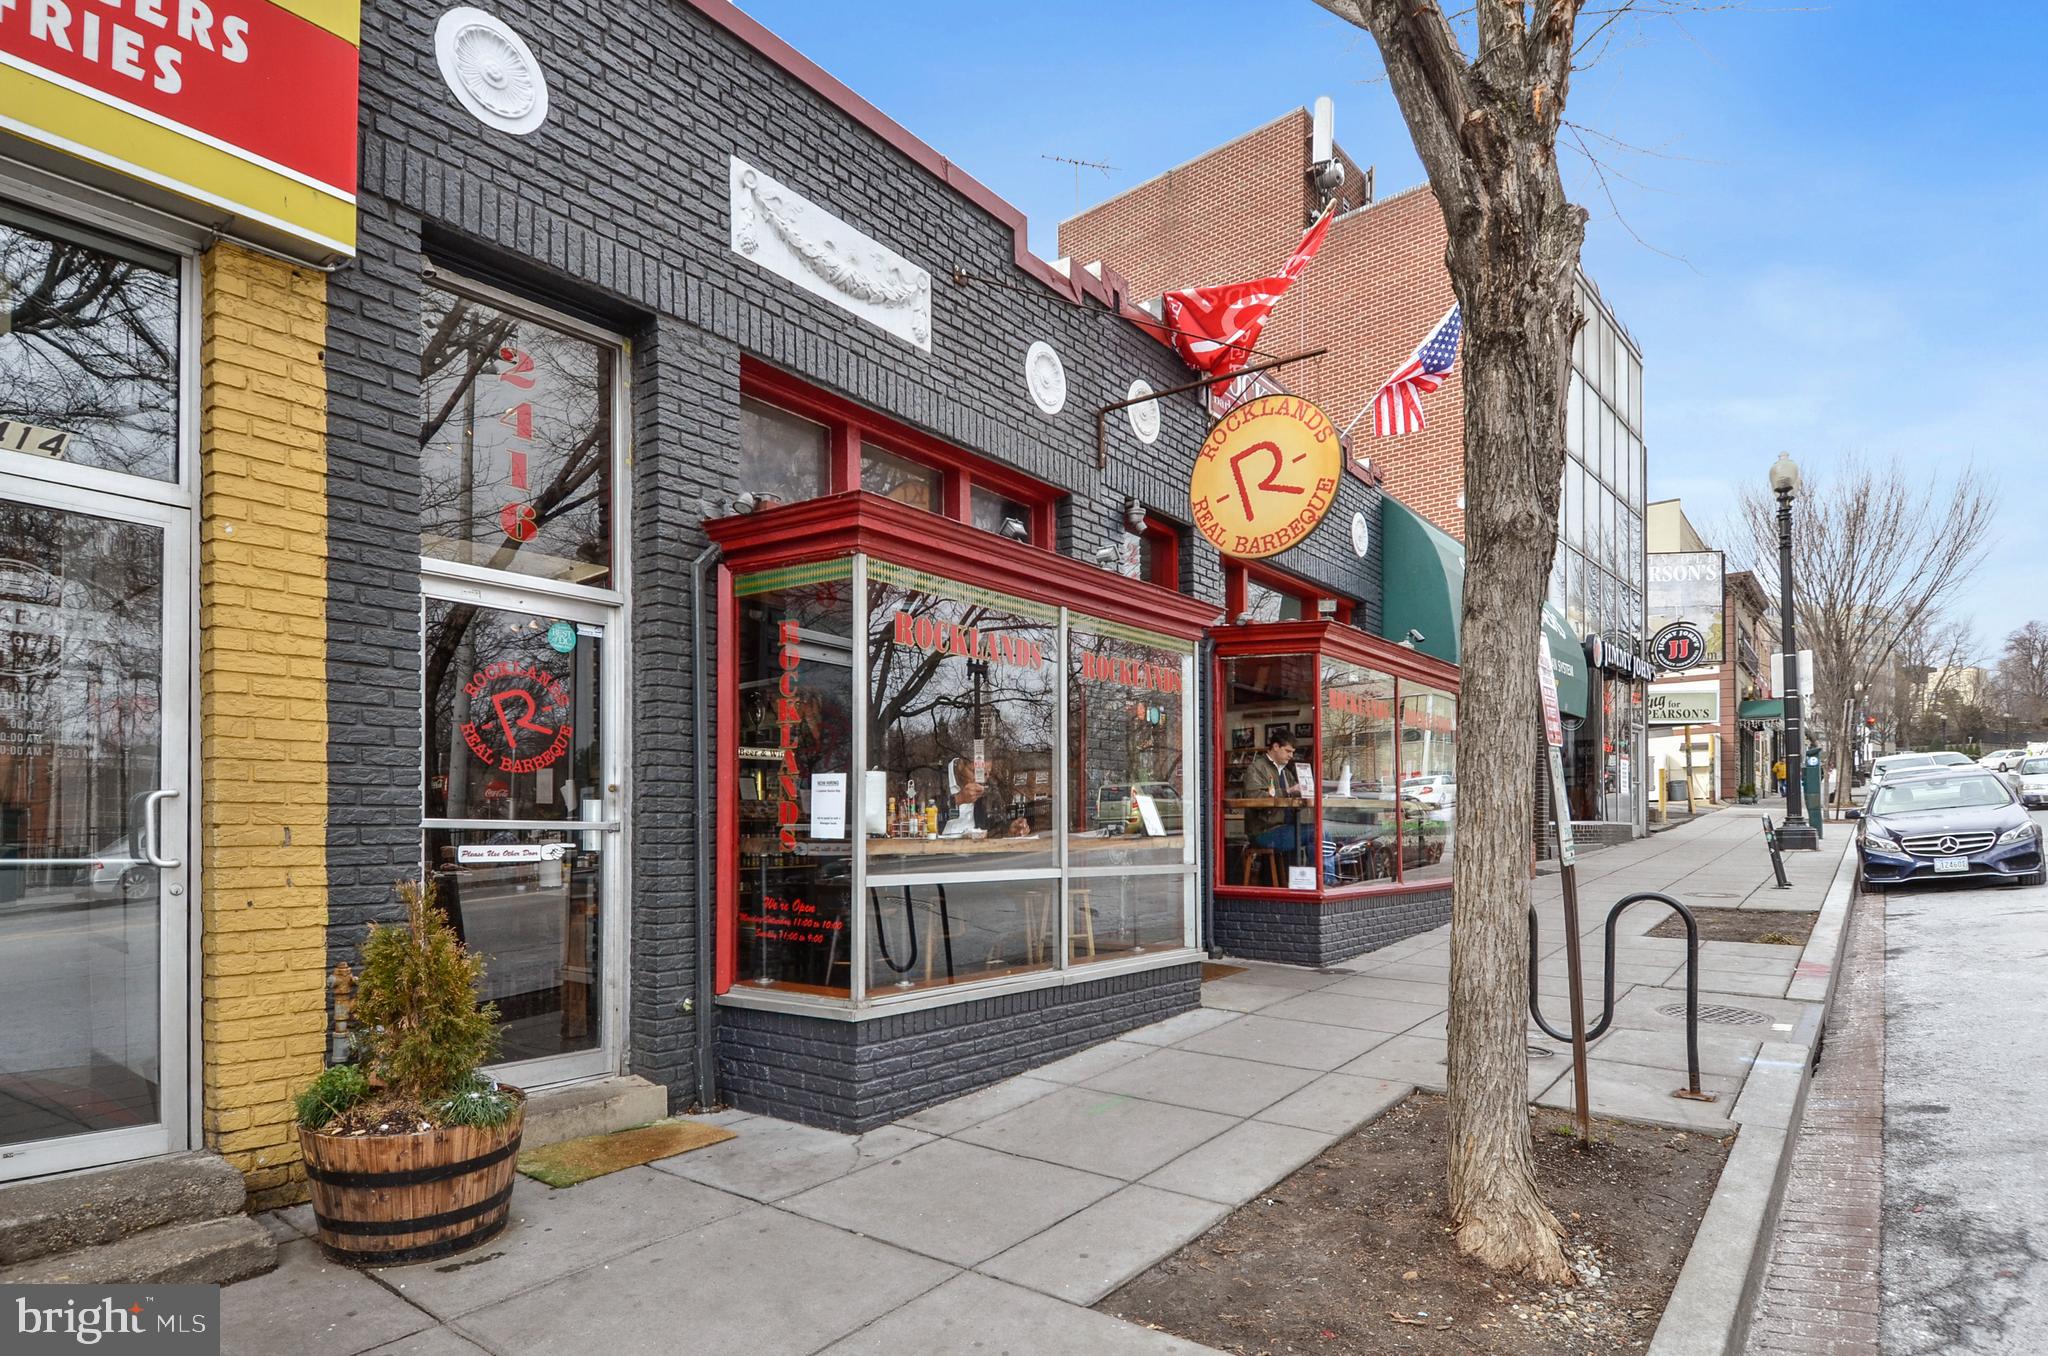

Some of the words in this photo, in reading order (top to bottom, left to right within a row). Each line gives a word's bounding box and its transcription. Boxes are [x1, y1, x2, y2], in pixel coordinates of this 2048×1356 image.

[0, 0, 182, 94] RIES
[104, 0, 248, 63] ERS
[499, 347, 539, 542] 2416
[1200, 398, 1334, 463] ROCKLANDS
[1230, 441, 1305, 522] R
[1193, 495, 1228, 547] REAL
[1232, 477, 1335, 554] BARBEQUE
[1648, 564, 1717, 582] RSON'S
[892, 610, 1044, 672] ROCKLANDS
[1605, 641, 1631, 671] JIMMY
[1632, 655, 1656, 682] JOHN'S
[1658, 631, 1677, 651] JIMMY
[1669, 639, 1689, 659] JJ
[463, 661, 569, 707] ROCKLANDS
[1082, 650, 1182, 695] ROCKLANDS
[1558, 660, 1575, 677] SYSTEM
[491, 689, 553, 749] R
[776, 619, 801, 853] ROCKLANDS
[460, 720, 495, 766] REAL
[499, 724, 574, 773] BARBEQUE
[739, 747, 758, 757] Beer
[522, 849, 538, 857] Door
[763, 896, 789, 911] We're
[792, 898, 816, 915] Open
[755, 928, 777, 940] Sunday
